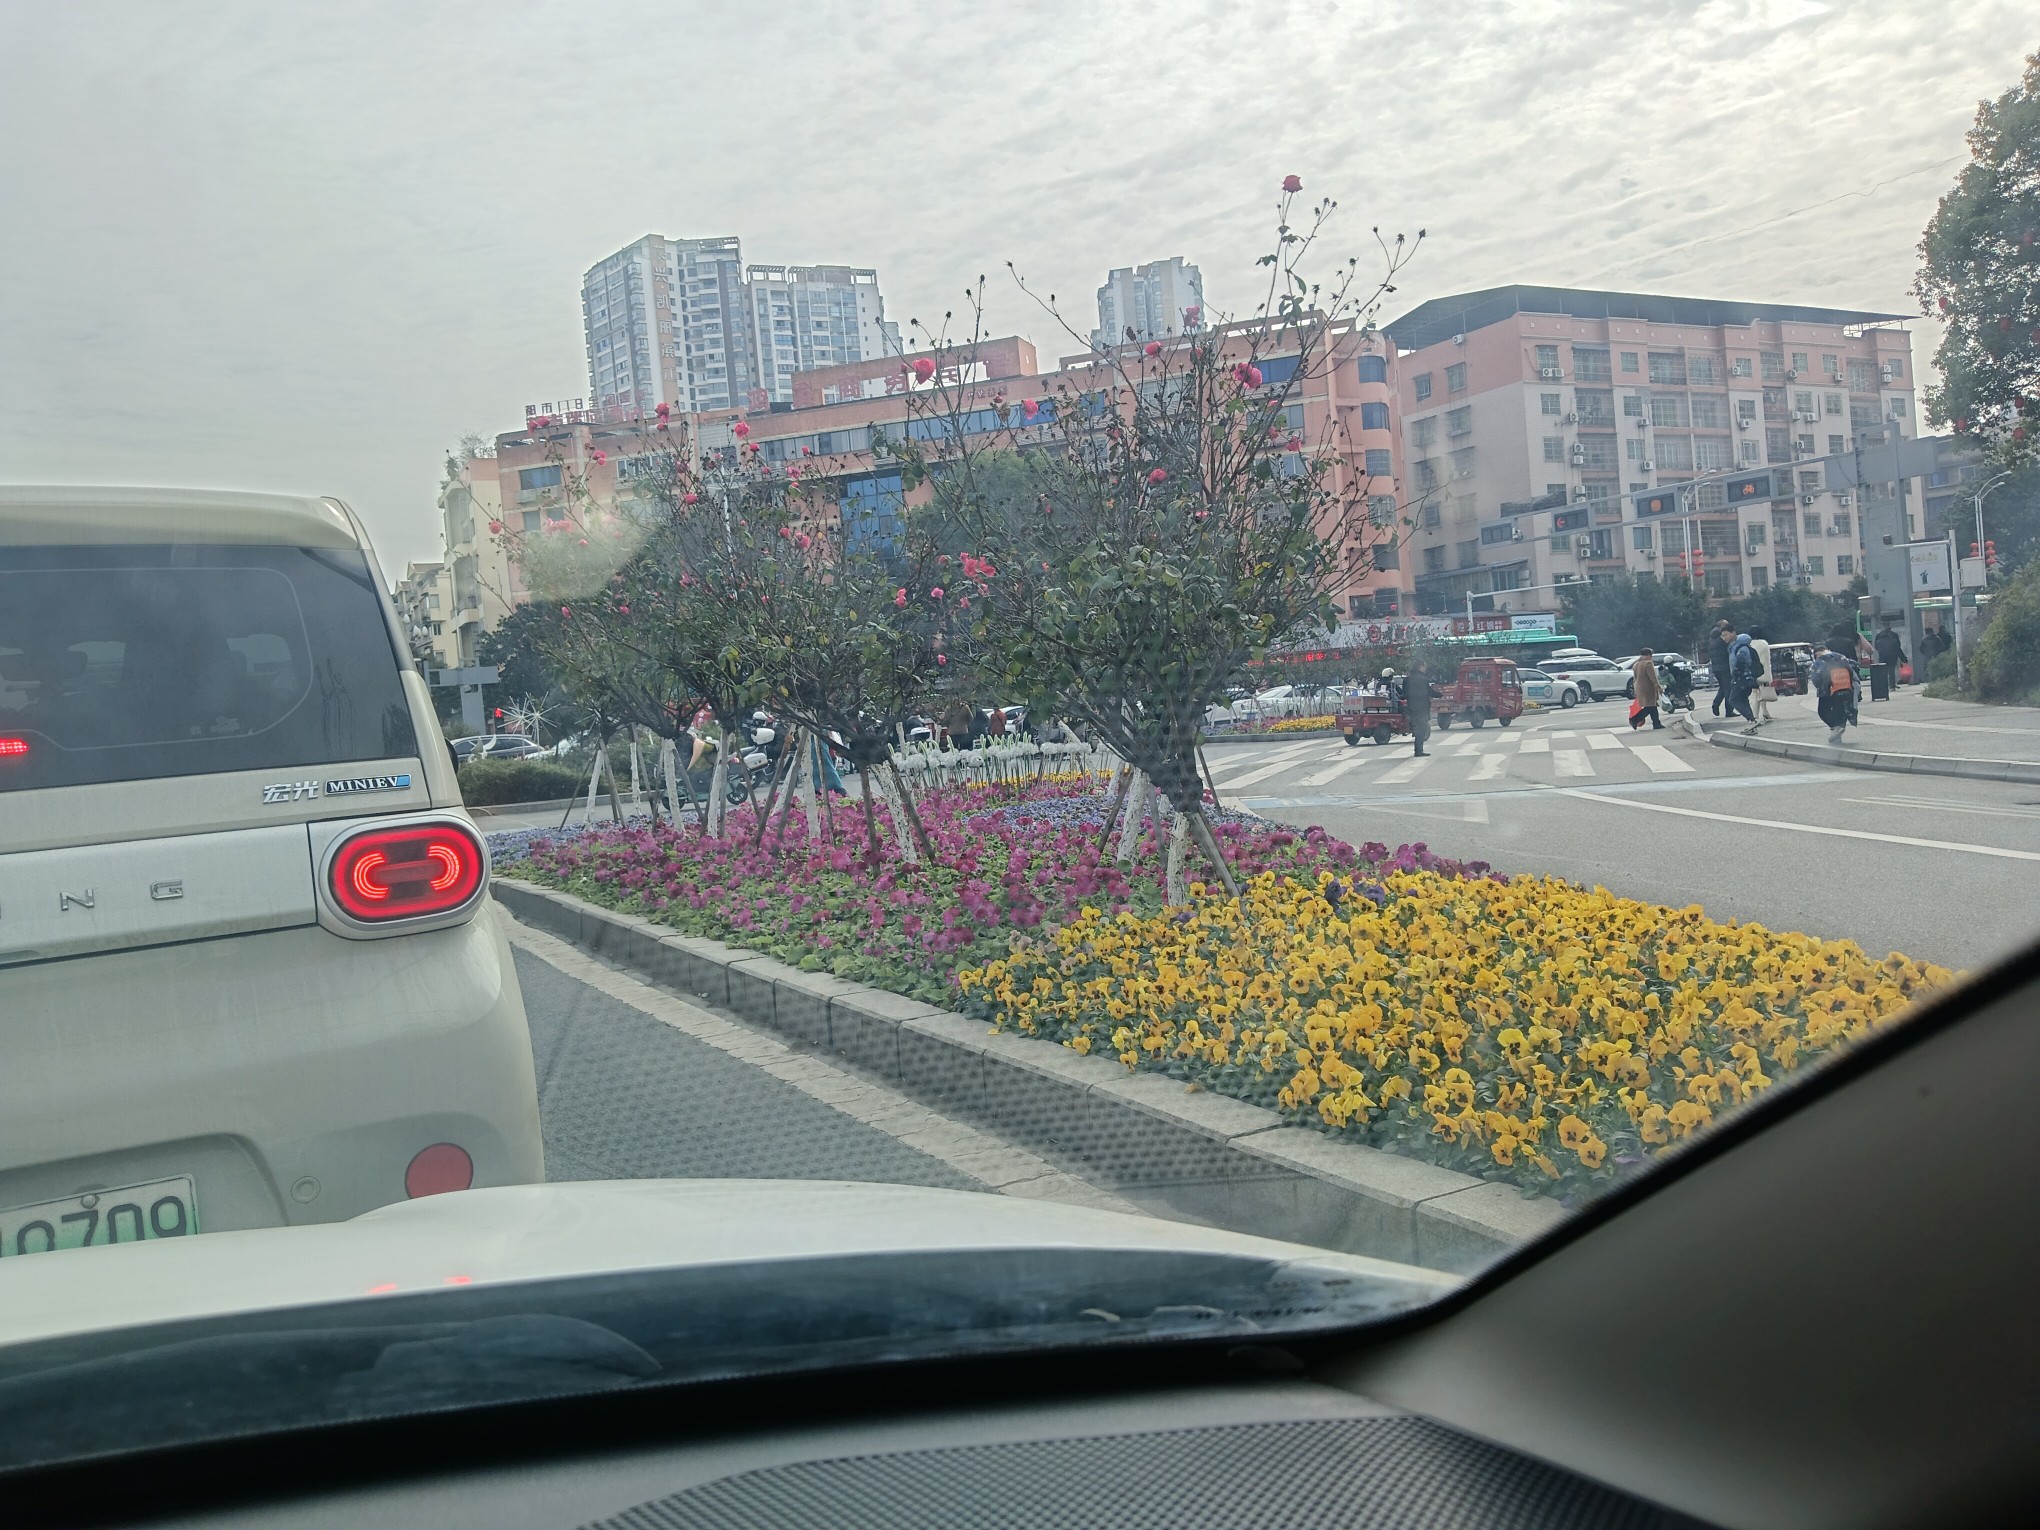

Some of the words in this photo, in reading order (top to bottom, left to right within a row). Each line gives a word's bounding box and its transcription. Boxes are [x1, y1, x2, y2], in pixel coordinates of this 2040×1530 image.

[263, 780, 319, 804] 宏光
[329, 776, 398, 793] MINIEV
[0, 879, 183, 920] NG
[0, 1195, 187, 1259] 709
